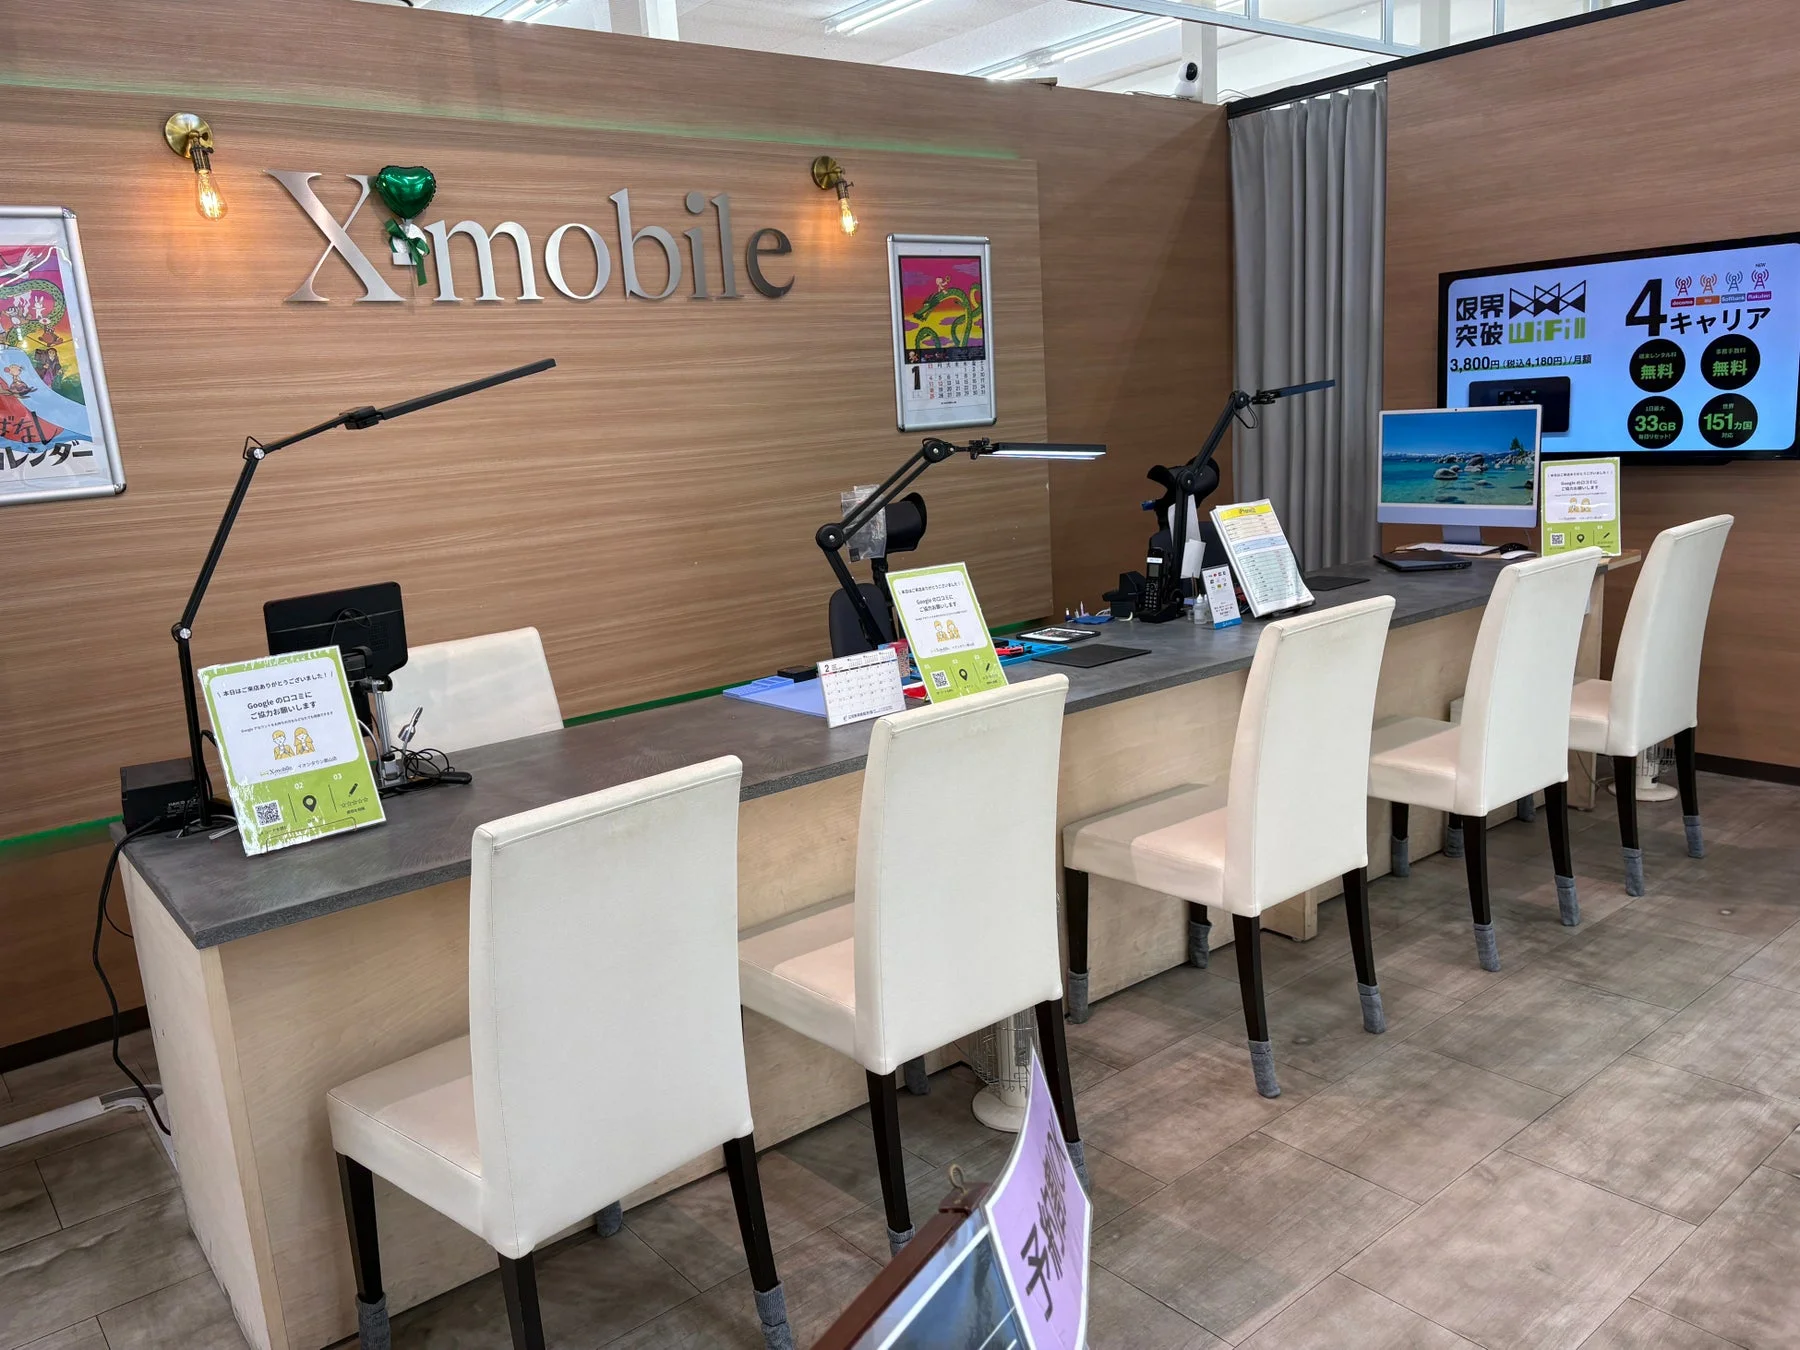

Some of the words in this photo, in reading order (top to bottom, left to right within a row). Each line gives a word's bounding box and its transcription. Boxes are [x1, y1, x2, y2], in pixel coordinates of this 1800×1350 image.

[1456, 293, 1504, 321] 限界
[1456, 321, 1503, 348] 突破
[1640, 362, 1674, 380] 無料
[1712, 359, 1748, 377] 無料
[911, 366, 921, 391] 1
[1634, 415, 1677, 432] 33GB
[247, 698, 274, 710] Google
[250, 701, 317, 720] ご協力お願いします
[332, 772, 343, 780] 03
[294, 781, 304, 790] 02
